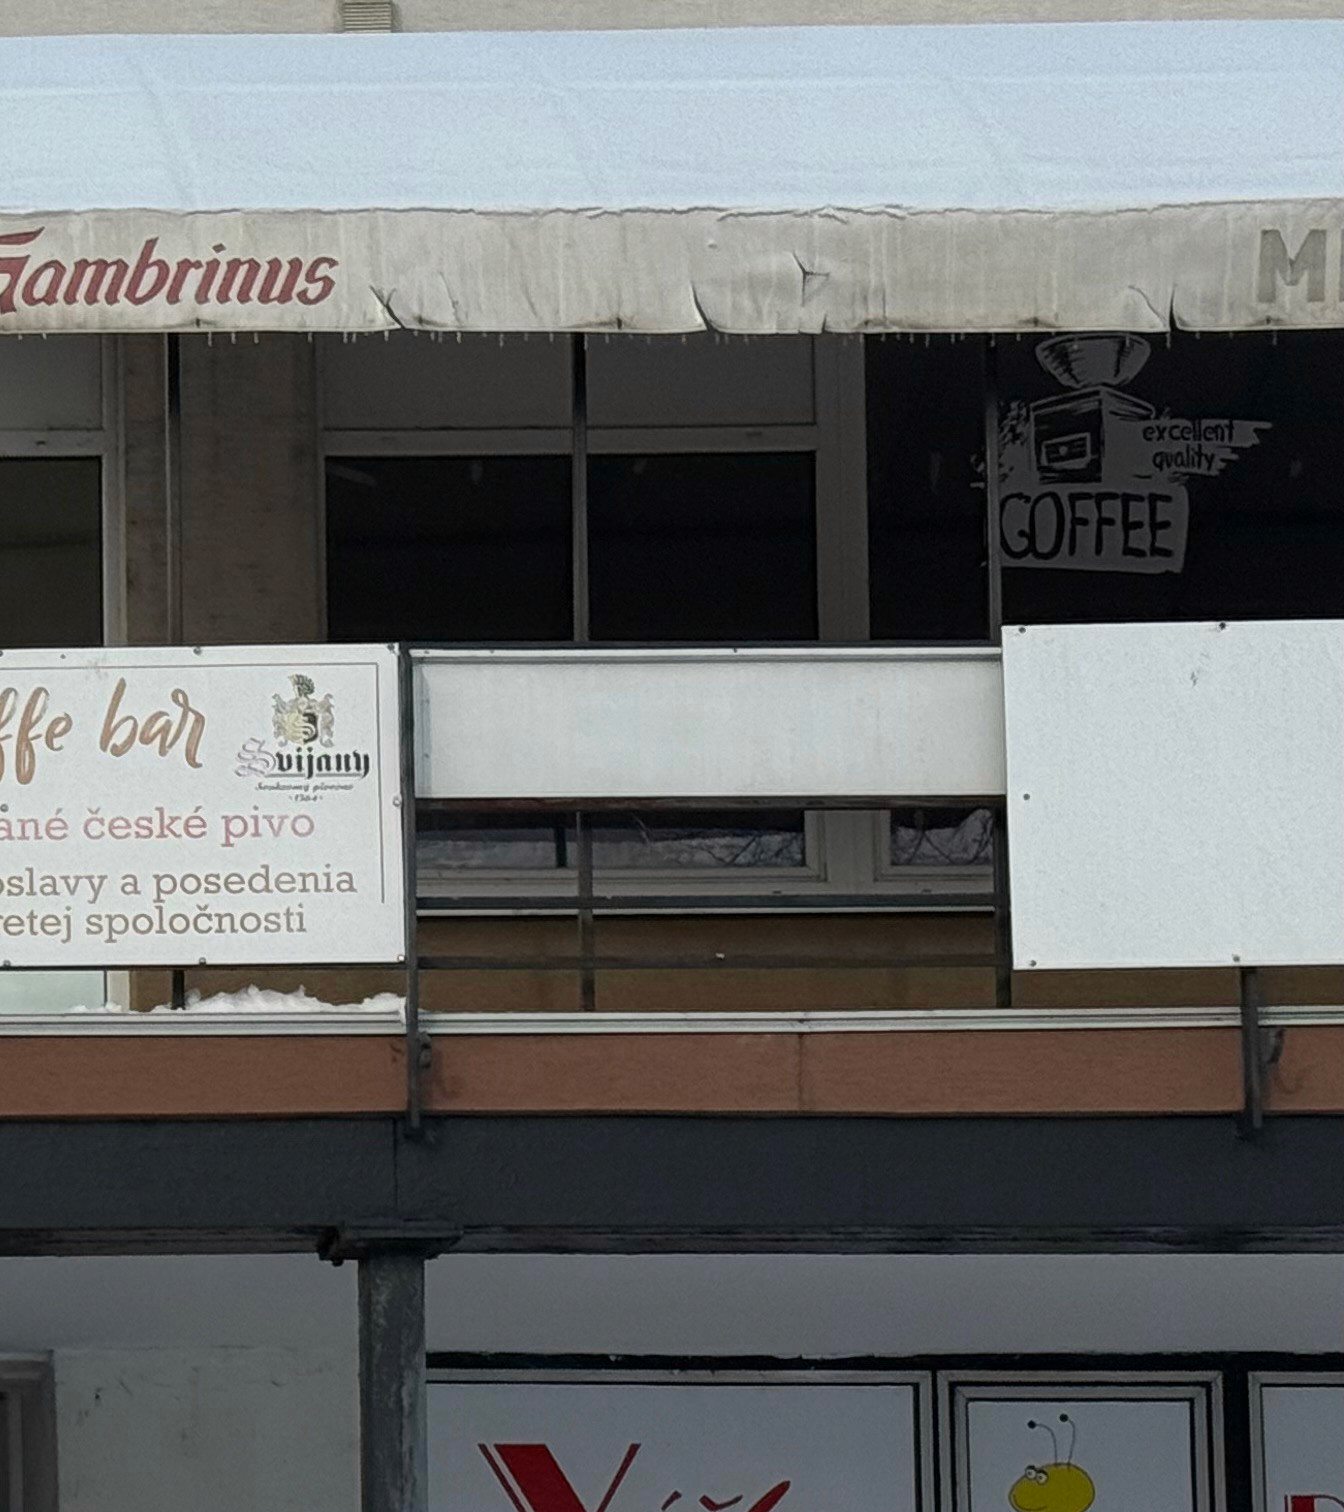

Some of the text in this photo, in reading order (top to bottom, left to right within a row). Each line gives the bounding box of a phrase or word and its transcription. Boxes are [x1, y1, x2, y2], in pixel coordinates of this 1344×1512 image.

[1143, 421, 1234, 443] excellent
[1153, 446, 1215, 471] quality
[999, 491, 1174, 560] COFFEE
[100, 677, 205, 769] bar
[234, 737, 370, 779] Svijany
[83, 805, 207, 840] české
[221, 805, 315, 847] pivo
[120, 873, 141, 895] a
[153, 864, 357, 903] posedenia
[86, 903, 307, 943] spoločnosti
